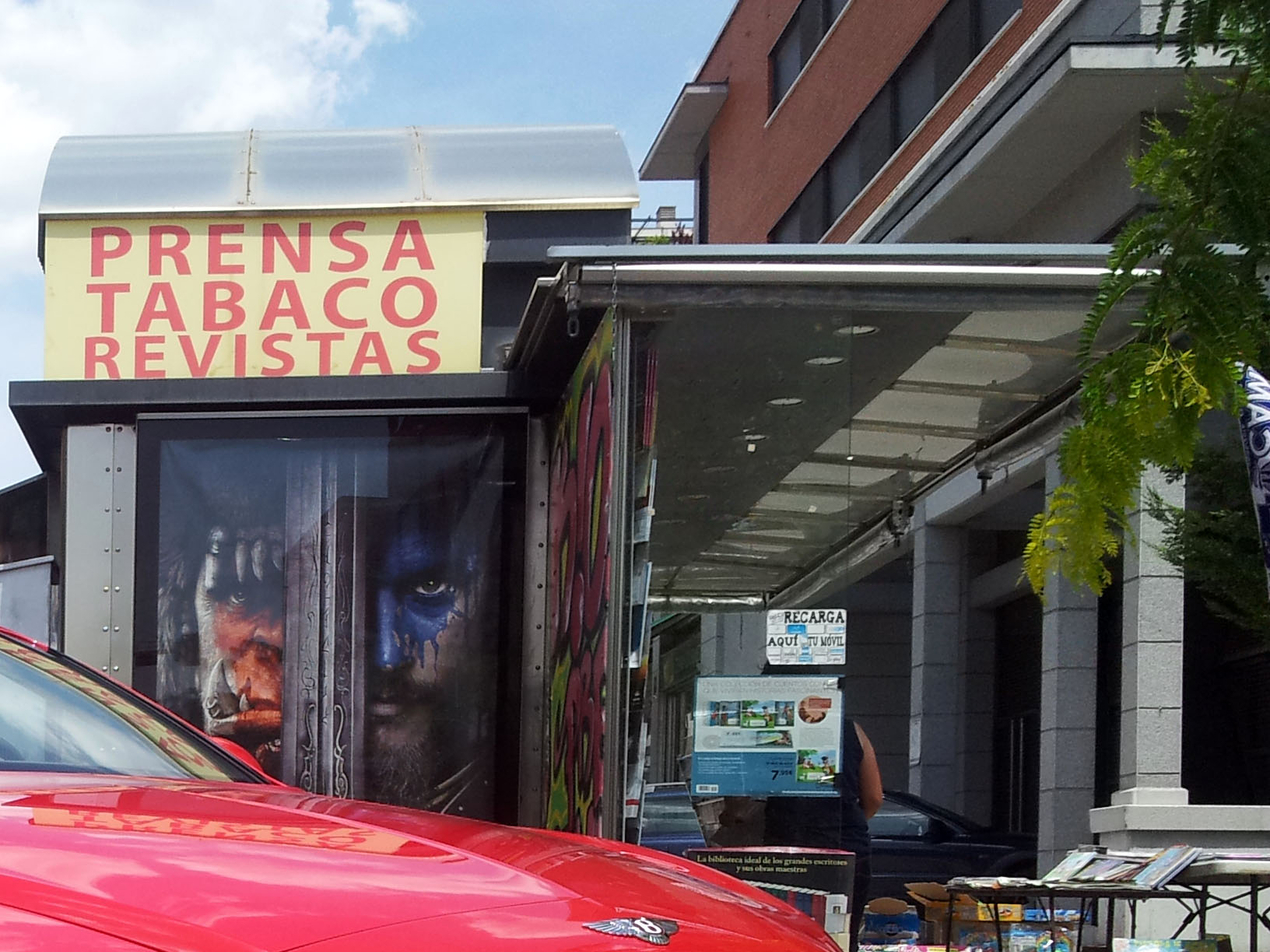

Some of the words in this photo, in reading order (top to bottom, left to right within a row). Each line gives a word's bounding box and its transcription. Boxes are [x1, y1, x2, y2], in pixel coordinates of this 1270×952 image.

[91, 220, 435, 277] PRENSA
[86, 276, 438, 333] TABACO
[84, 330, 441, 379] REVISTAS
[784, 611, 845, 624] RECARGA
[767, 634, 798, 647] AQUÍ
[808, 636, 819, 647] TU
[820, 633, 844, 647] MÓVIL
[697, 855, 706, 863] La
[707, 855, 743, 864] biblioteca
[744, 856, 761, 864] ideal
[773, 857, 782, 865] los
[783, 857, 812, 866] grandes
[814, 858, 848, 866] escritores
